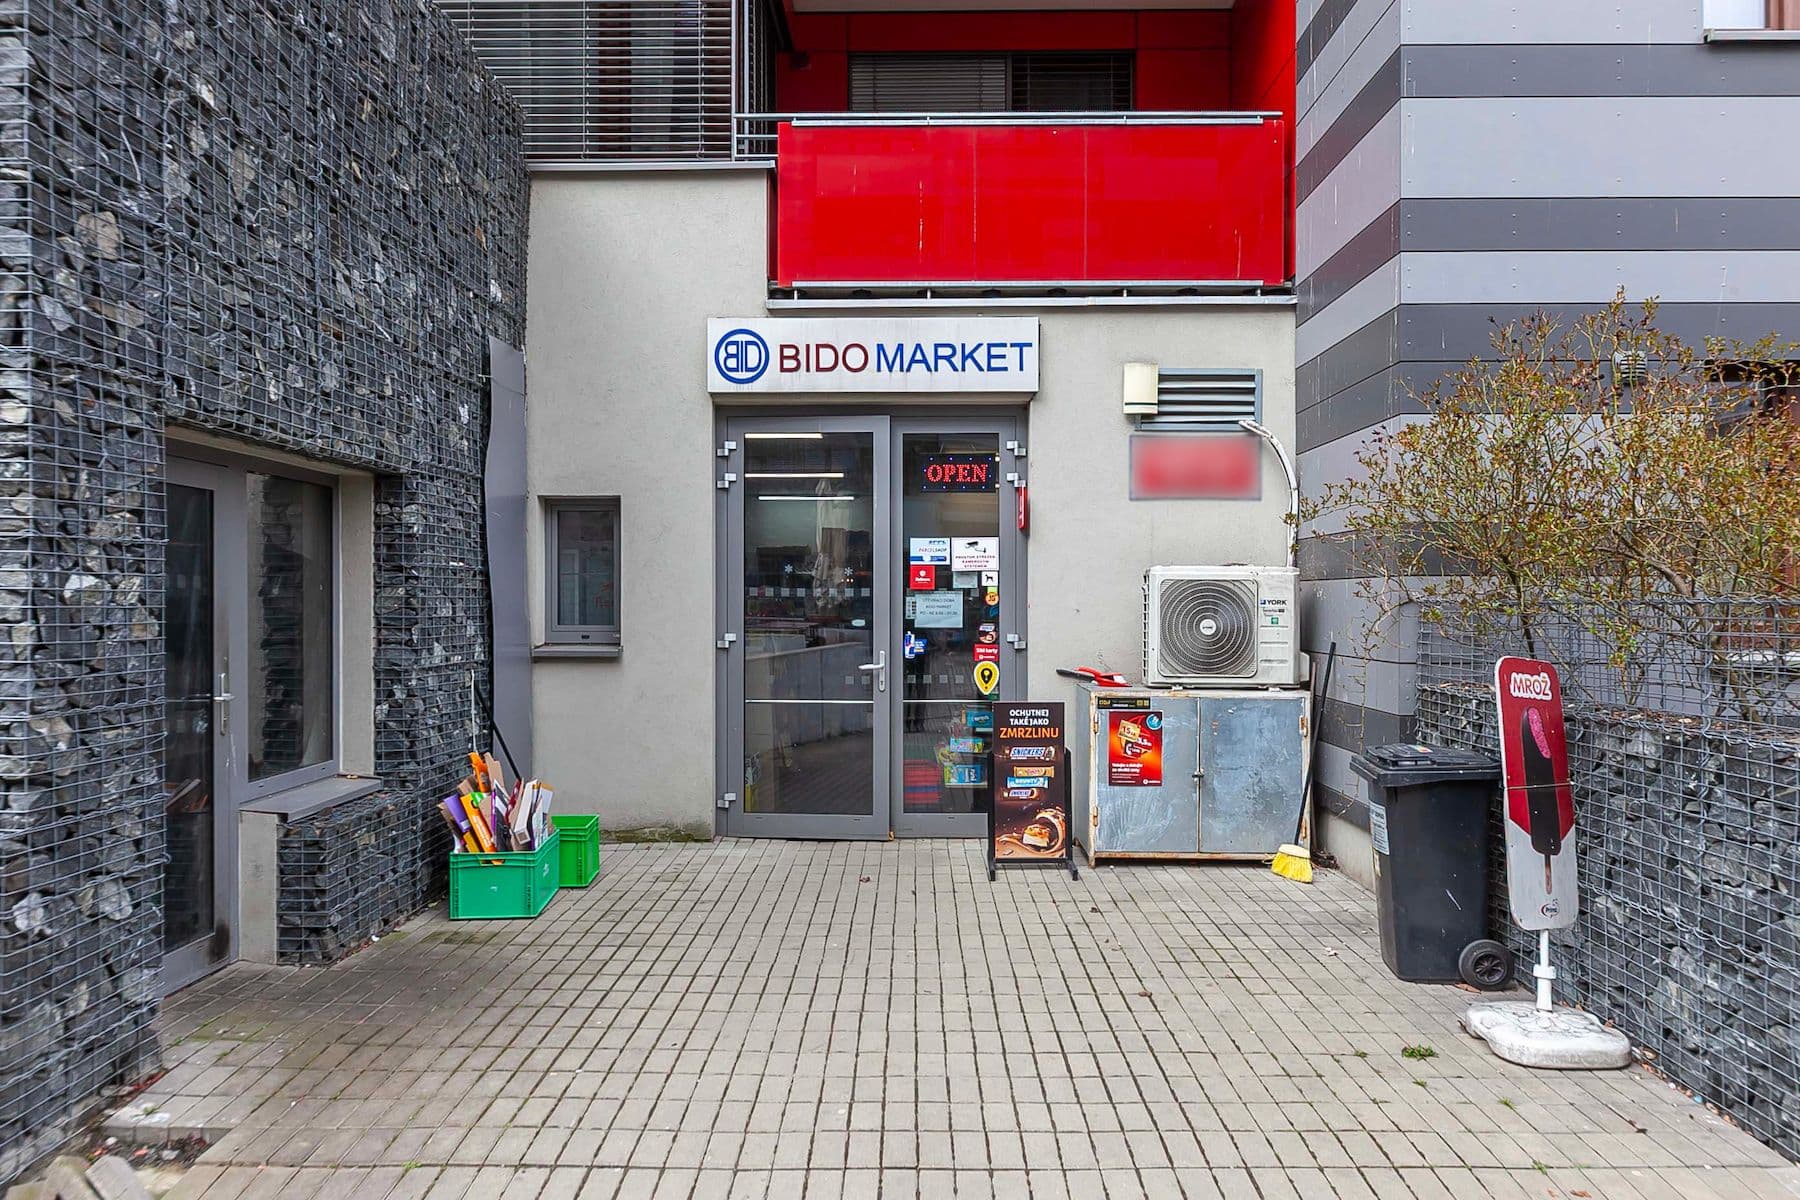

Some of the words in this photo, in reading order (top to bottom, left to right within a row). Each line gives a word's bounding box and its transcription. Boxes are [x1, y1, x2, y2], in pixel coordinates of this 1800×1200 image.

[779, 343, 869, 373] BIDO
[876, 342, 1033, 373] MARKET
[926, 464, 988, 482] OPEN
[1009, 709, 1049, 717] OCHUTNEJ
[1009, 716, 1028, 726] TAKÉ
[1029, 718, 1049, 726] JAKO
[1000, 728, 1059, 738] ZMRZLINU
[1011, 748, 1044, 756] SNICKERS
